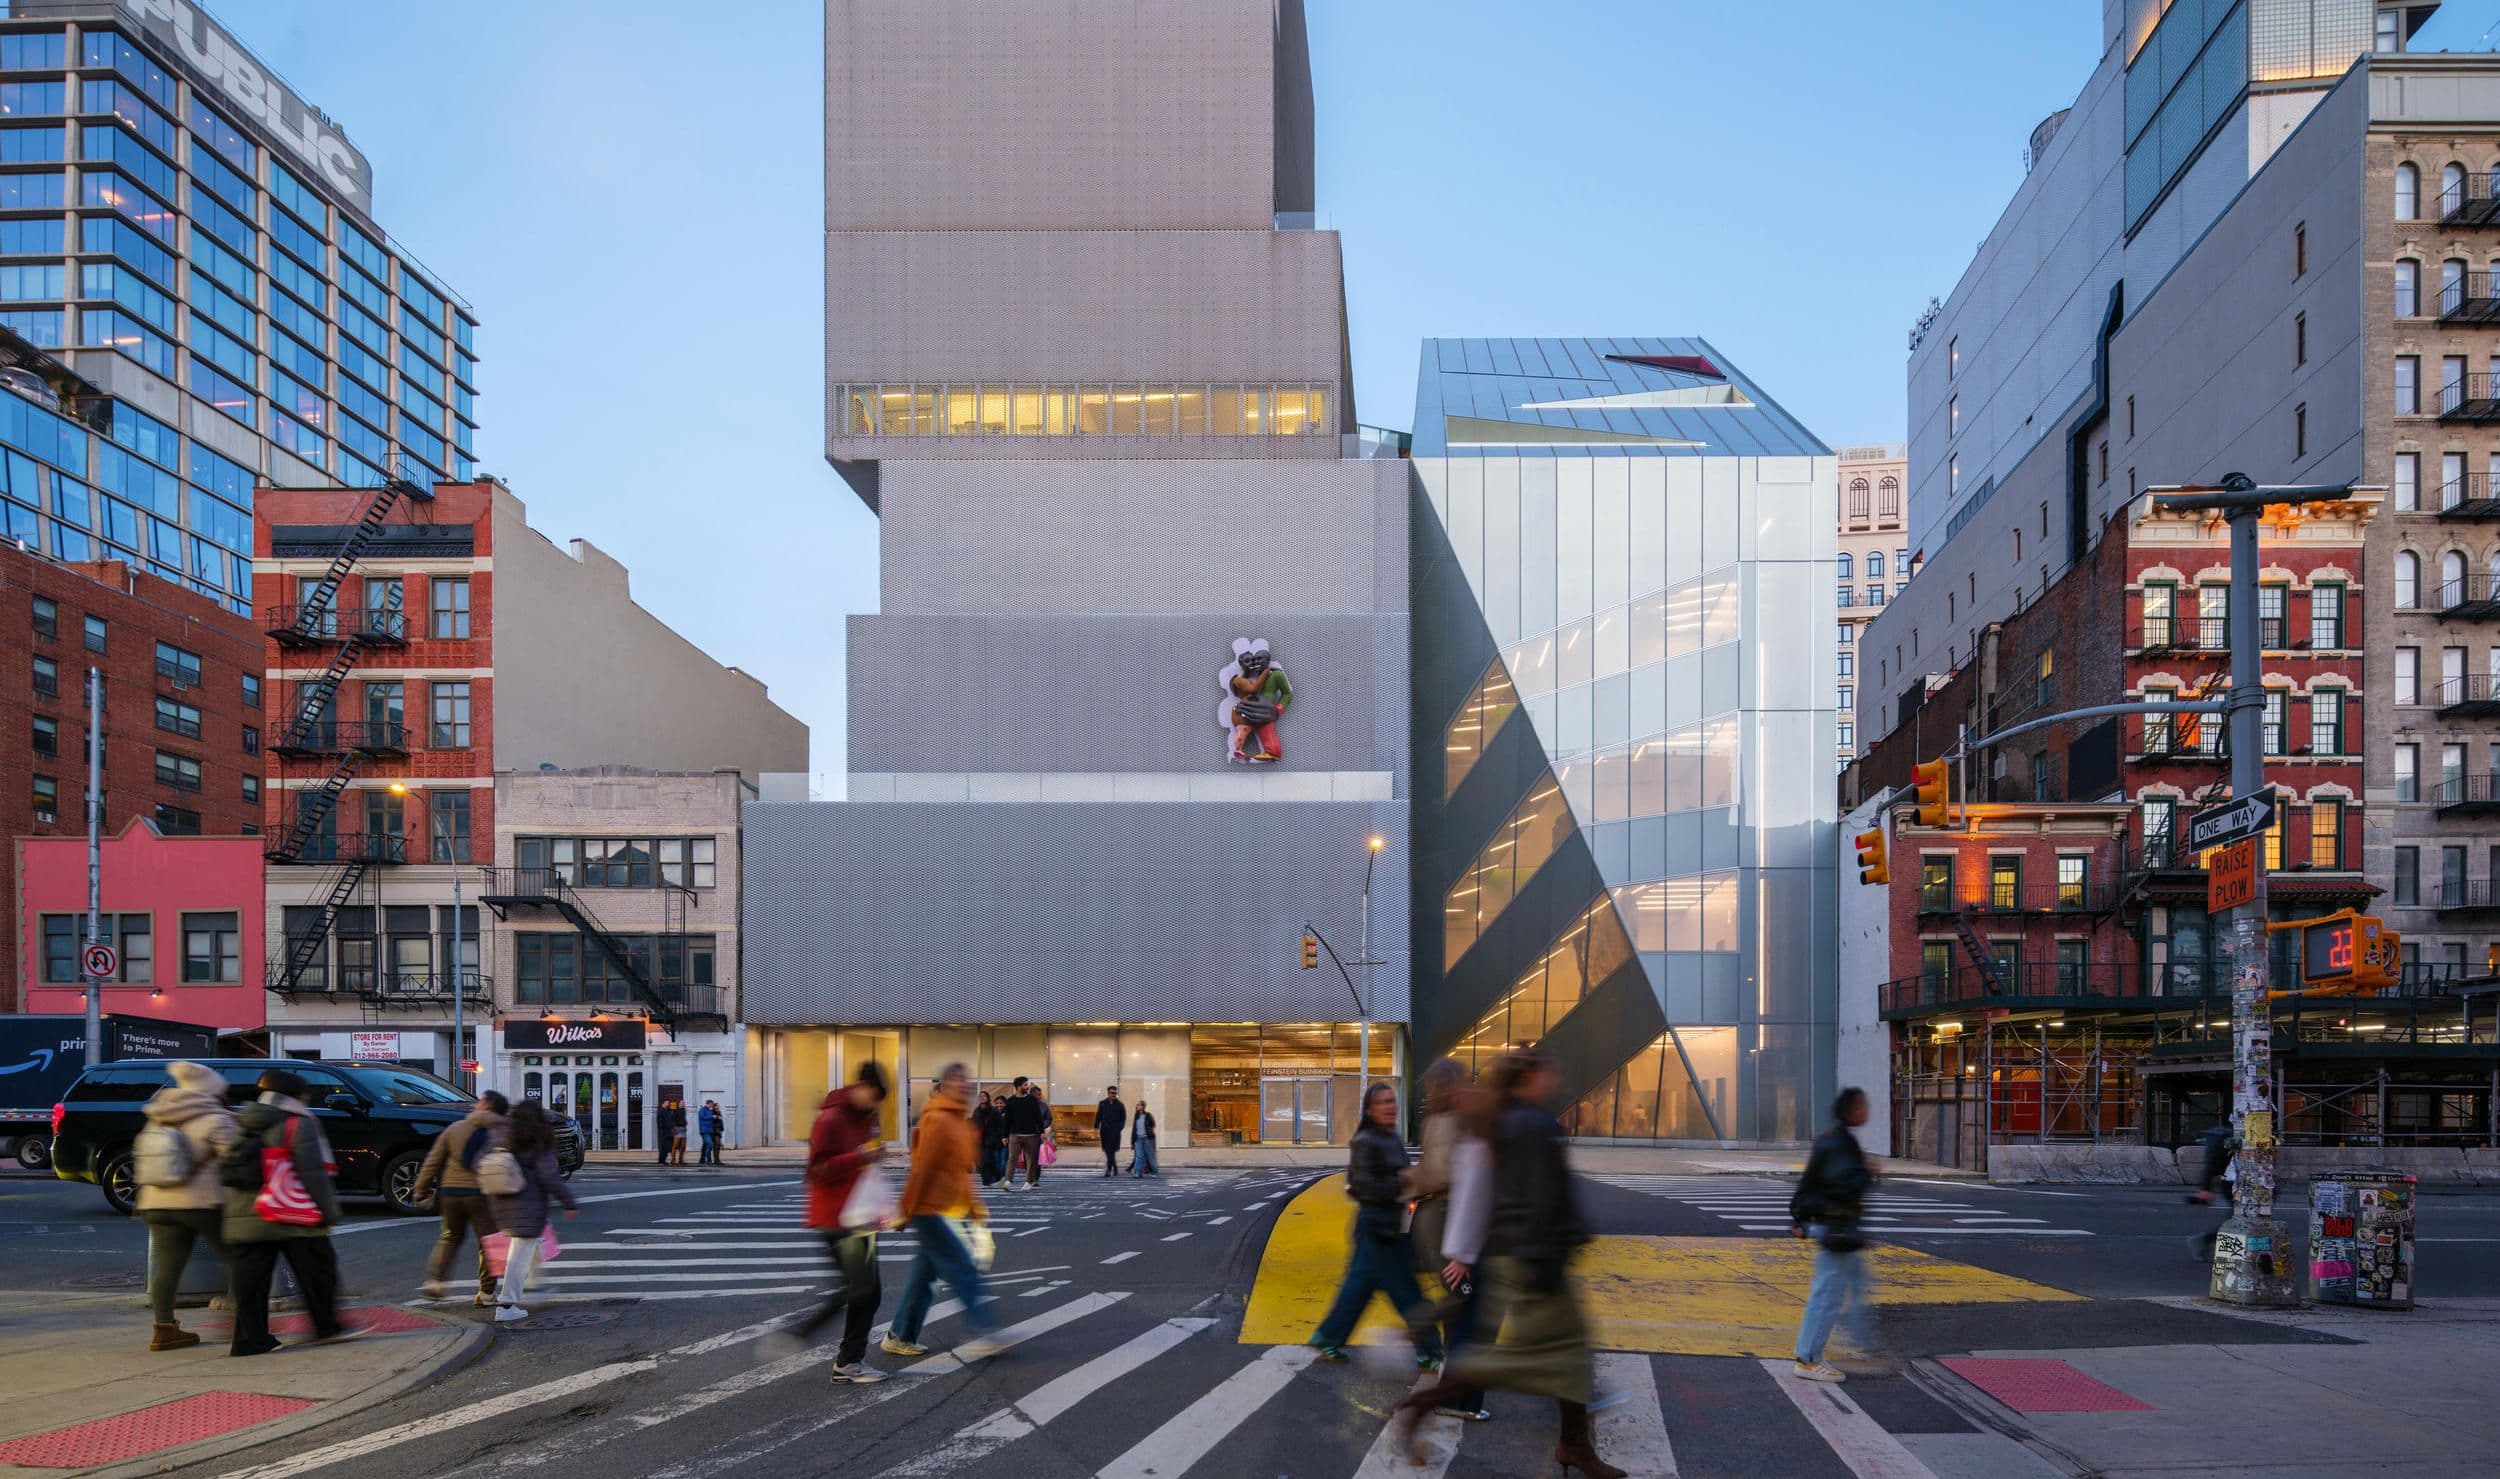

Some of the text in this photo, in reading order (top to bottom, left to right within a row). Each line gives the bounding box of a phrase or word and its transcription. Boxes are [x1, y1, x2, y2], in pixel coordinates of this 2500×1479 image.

[2198, 806, 2257, 839] ONE WAY
[2215, 848, 2249, 877] RAISE
[2215, 877, 2247, 905] PLOW
[123, 1033, 180, 1048] There's more
[353, 1033, 397, 1041] STORE FOR RENT
[547, 1024, 602, 1044] Wilka's
[123, 1043, 164, 1055] to Prime.
